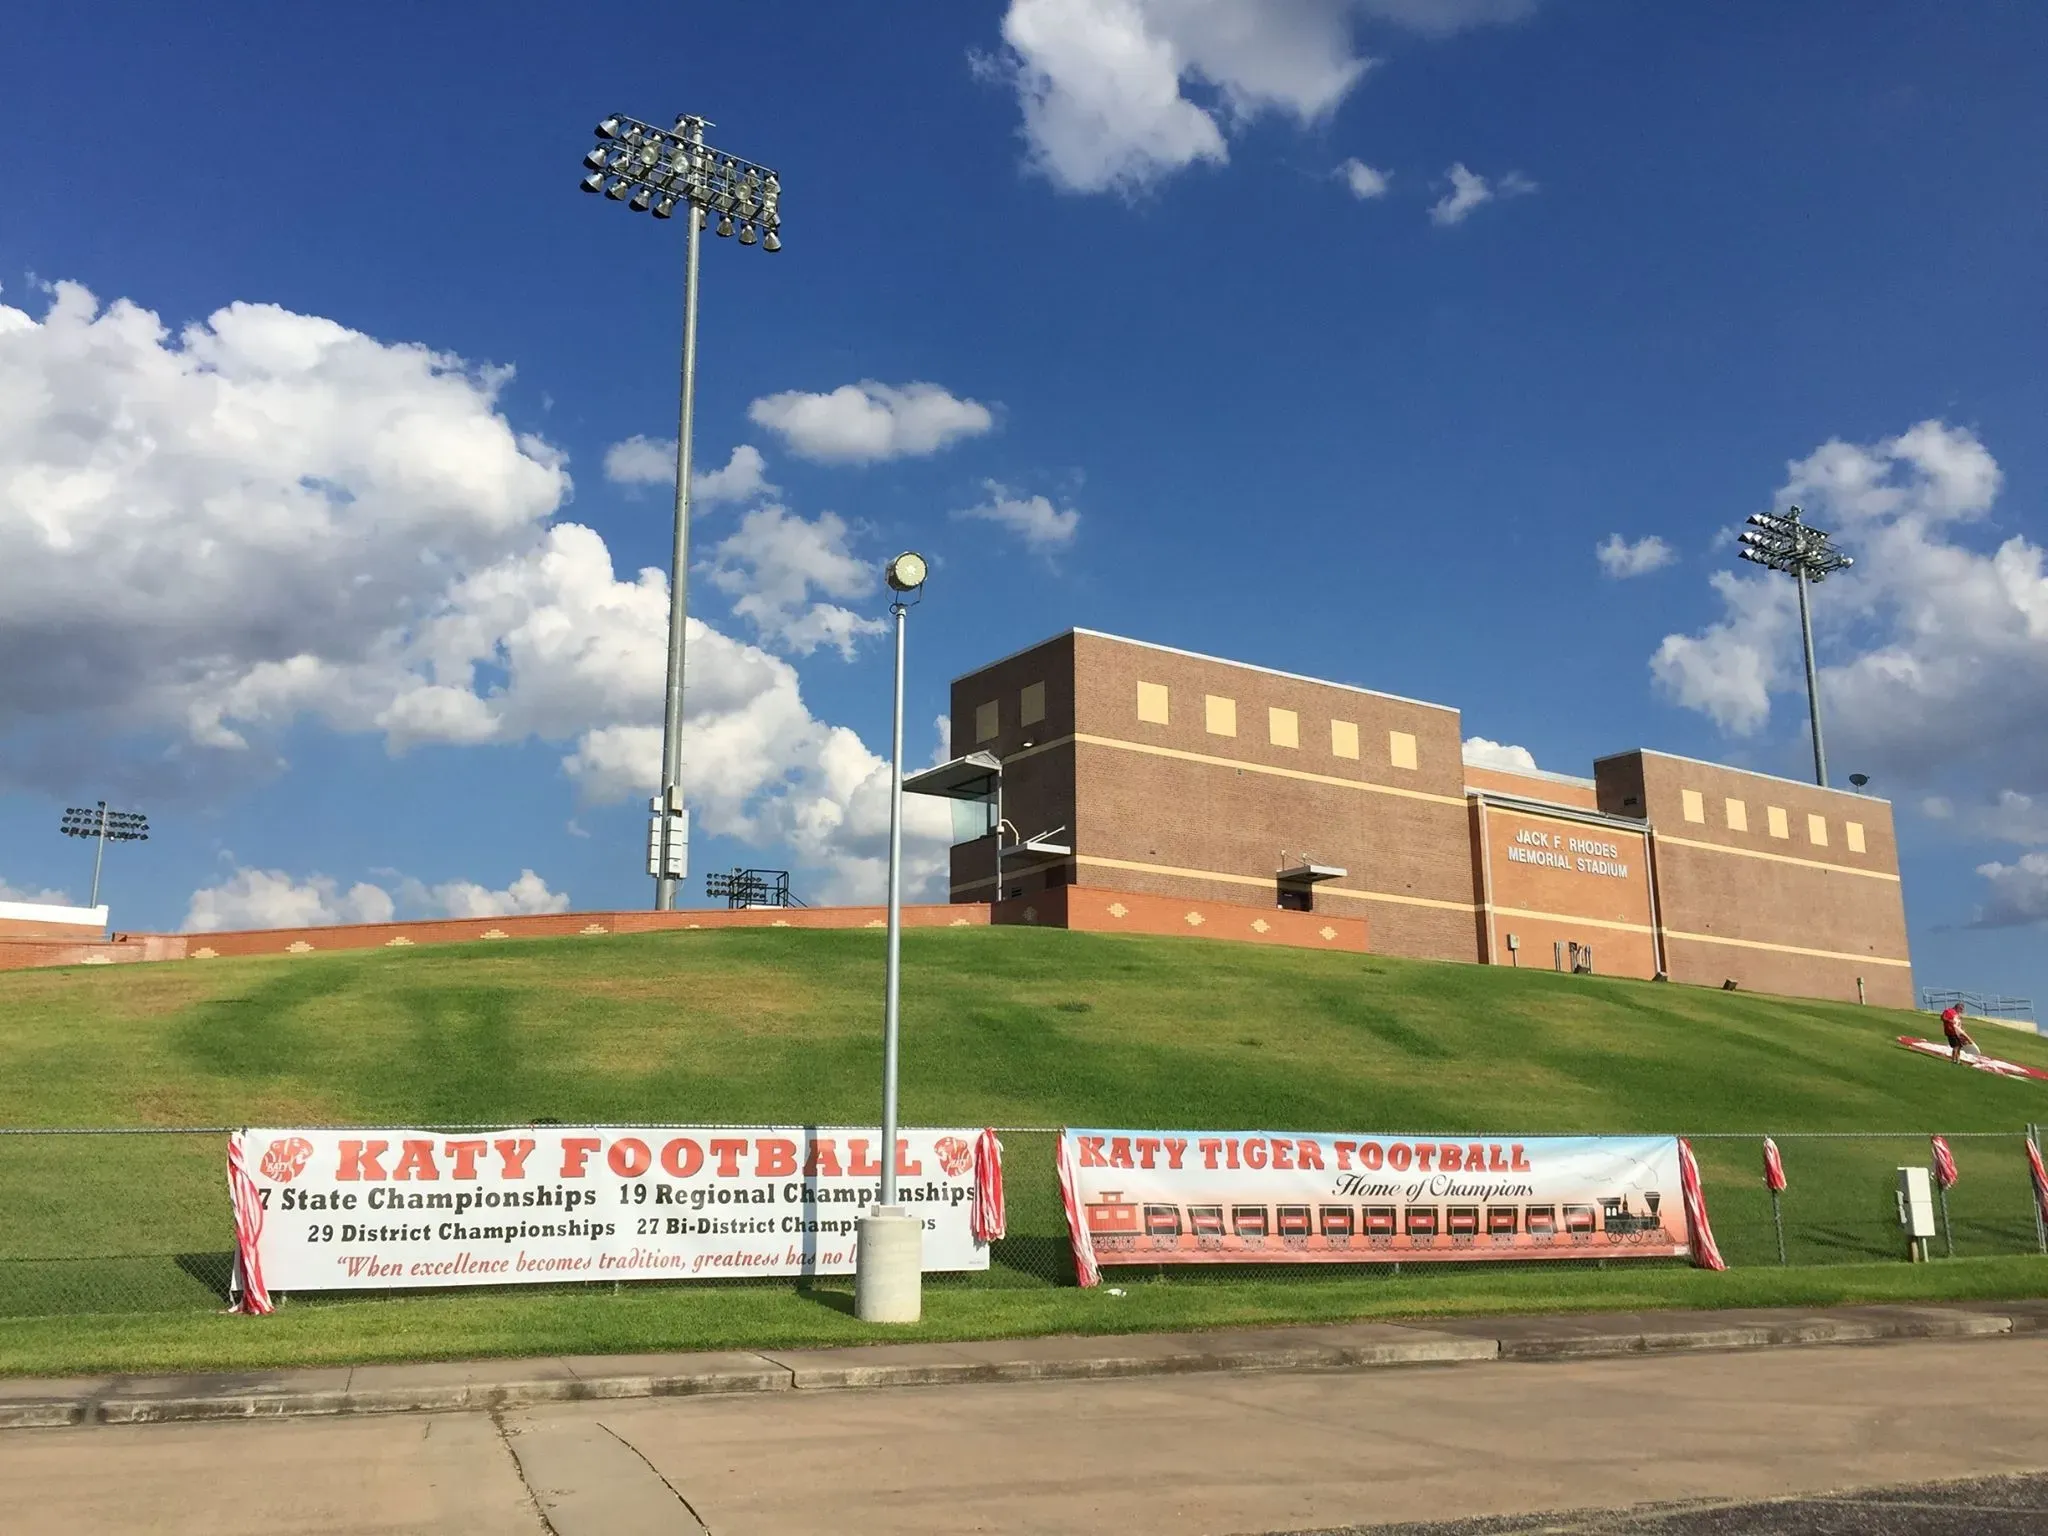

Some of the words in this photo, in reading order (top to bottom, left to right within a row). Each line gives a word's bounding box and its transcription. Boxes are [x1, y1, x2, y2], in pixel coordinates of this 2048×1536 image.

[1516, 829, 1548, 847] JACK
[1554, 836, 1565, 850] F.
[1569, 838, 1617, 858] RHODES
[1508, 847, 1572, 870] MEMORIAL
[1577, 857, 1628, 878] STADIUM
[335, 1139, 535, 1181] KATY
[560, 1137, 922, 1179] FOOTBALL
[1077, 1136, 1187, 1170] KATY
[1200, 1138, 1325, 1170] TIGER
[1334, 1141, 1532, 1172] FOOTBALL
[281, 1187, 357, 1211] State
[368, 1185, 597, 1215] Championships
[620, 1183, 646, 1204] 19
[655, 1183, 775, 1210] Regional
[783, 1181, 974, 1208] Champinships
[1331, 1173, 1401, 1197] Home
[1406, 1176, 1430, 1202] of
[1430, 1174, 1533, 1202] Champions
[308, 1225, 333, 1243] 29
[341, 1222, 431, 1242] District
[438, 1219, 615, 1243] Championships
[636, 1218, 659, 1235] 27
[665, 1217, 775, 1235] Bi-District
[411, 1252, 508, 1276] excellence
[516, 1251, 591, 1272] becomes
[599, 1248, 686, 1271] tradition,
[692, 1250, 779, 1272] greatness
[785, 1245, 816, 1265] has
[822, 1252, 842, 1265] no
